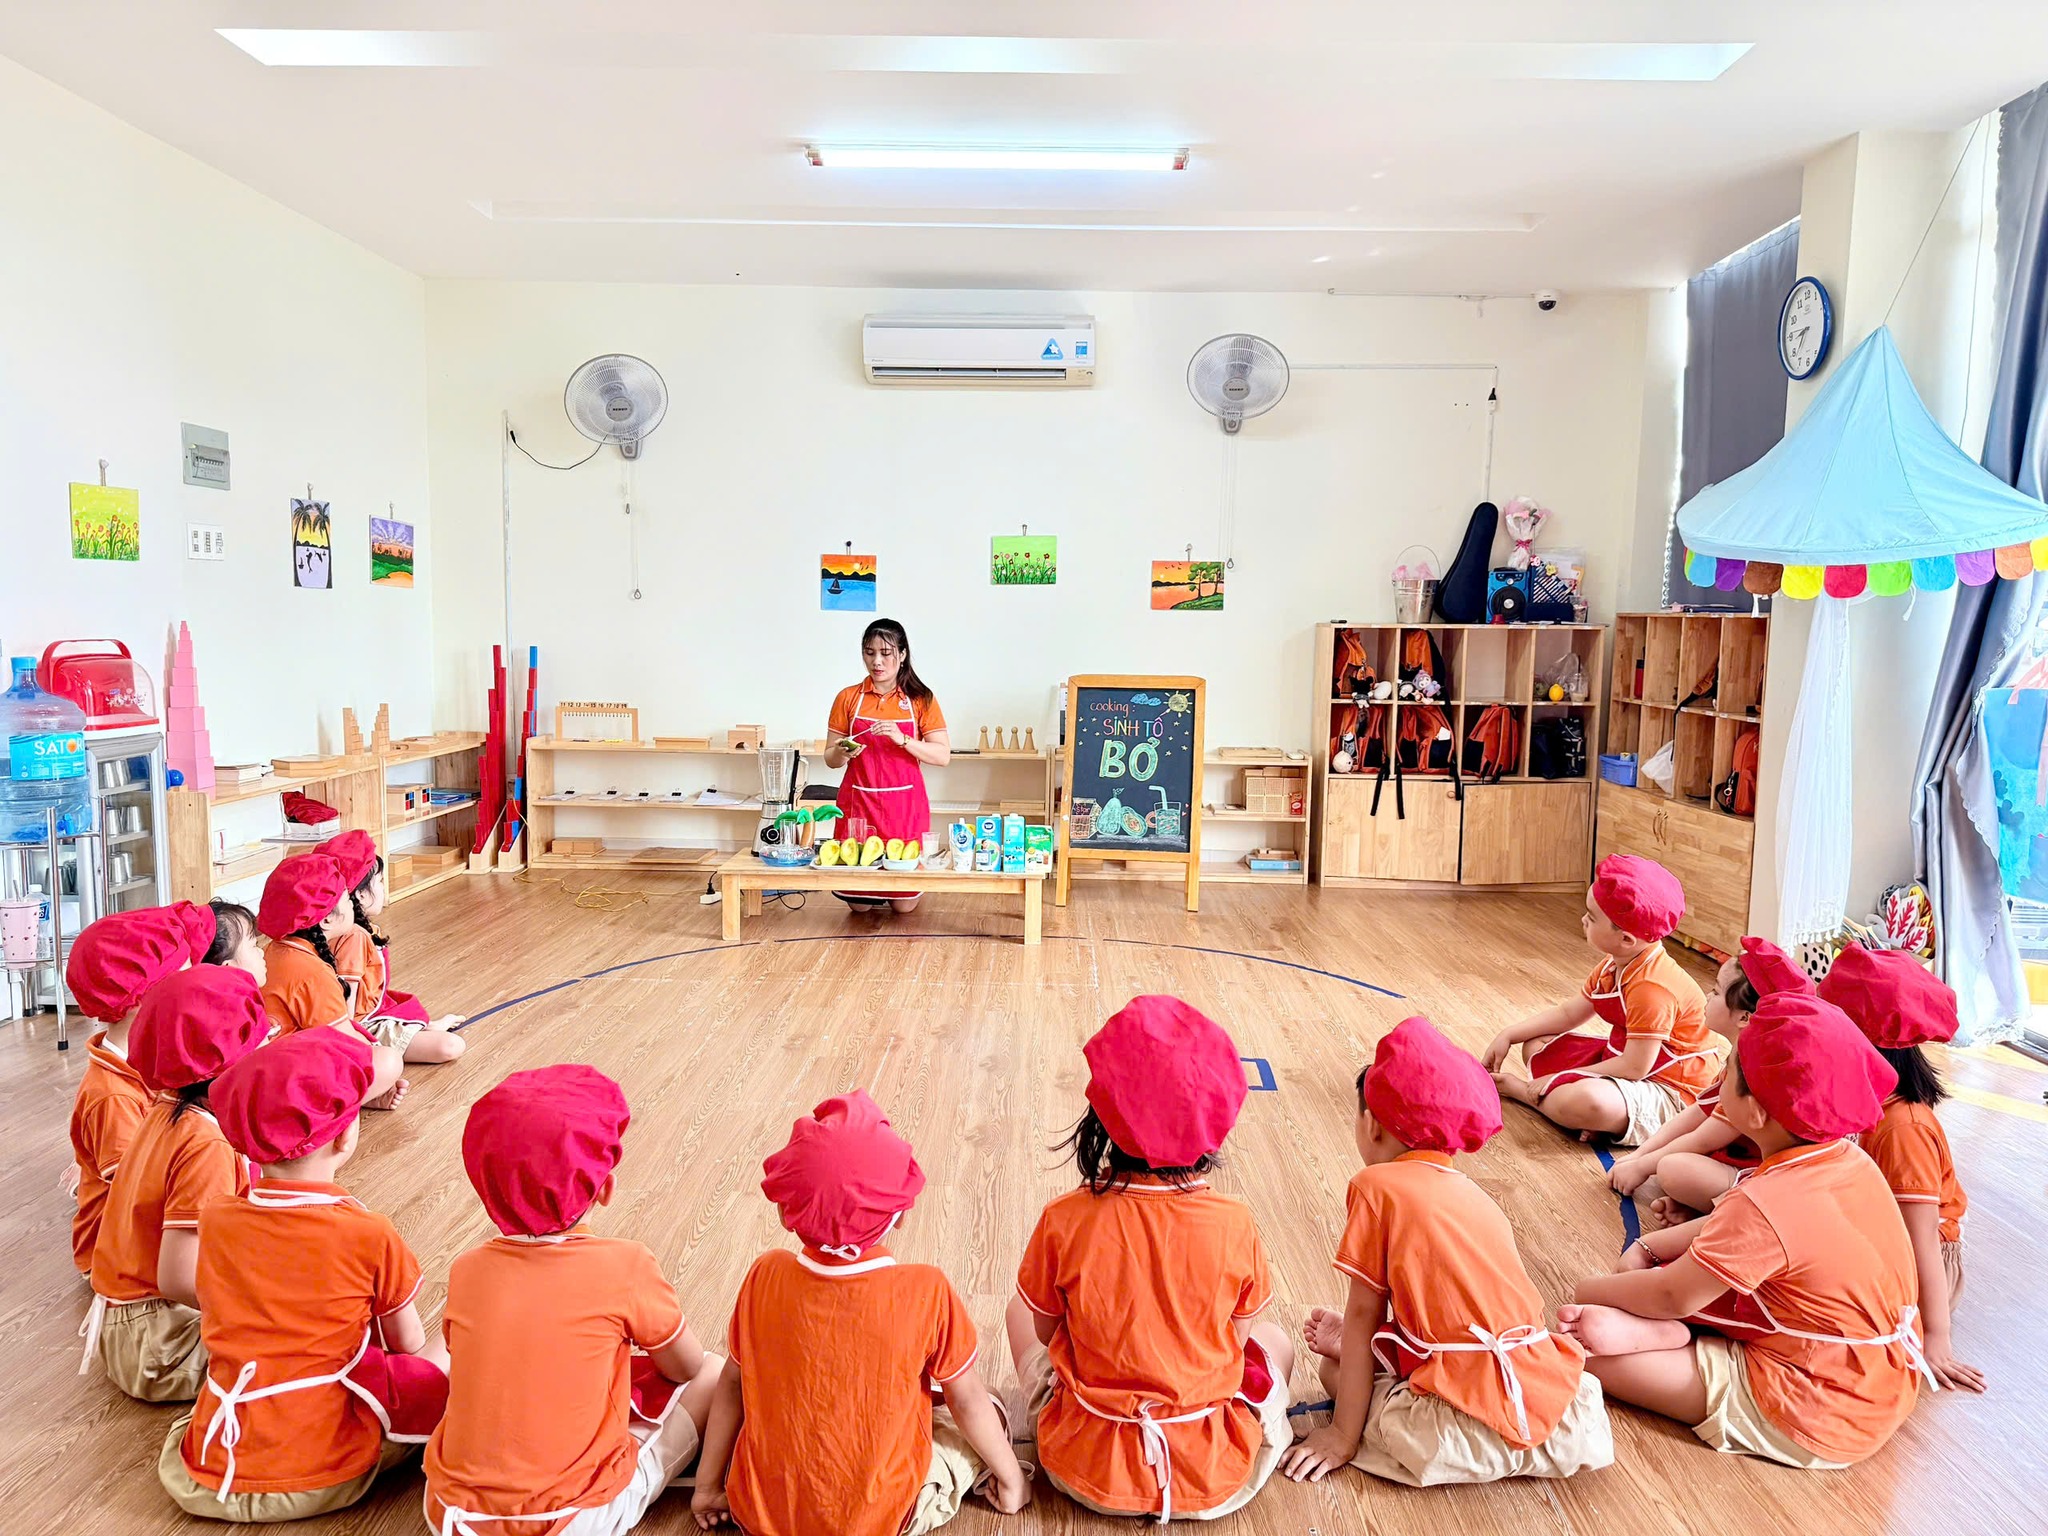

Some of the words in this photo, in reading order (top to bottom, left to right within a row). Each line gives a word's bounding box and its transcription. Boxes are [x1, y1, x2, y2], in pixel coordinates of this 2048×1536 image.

[1804, 290, 1810, 300] 12
[1796, 299, 1803, 309] 11
[1791, 315, 1797, 325] 10
[1791, 347, 1797, 357] 8
[1797, 357, 1802, 367] 7
[1805, 357, 1811, 367] 6
